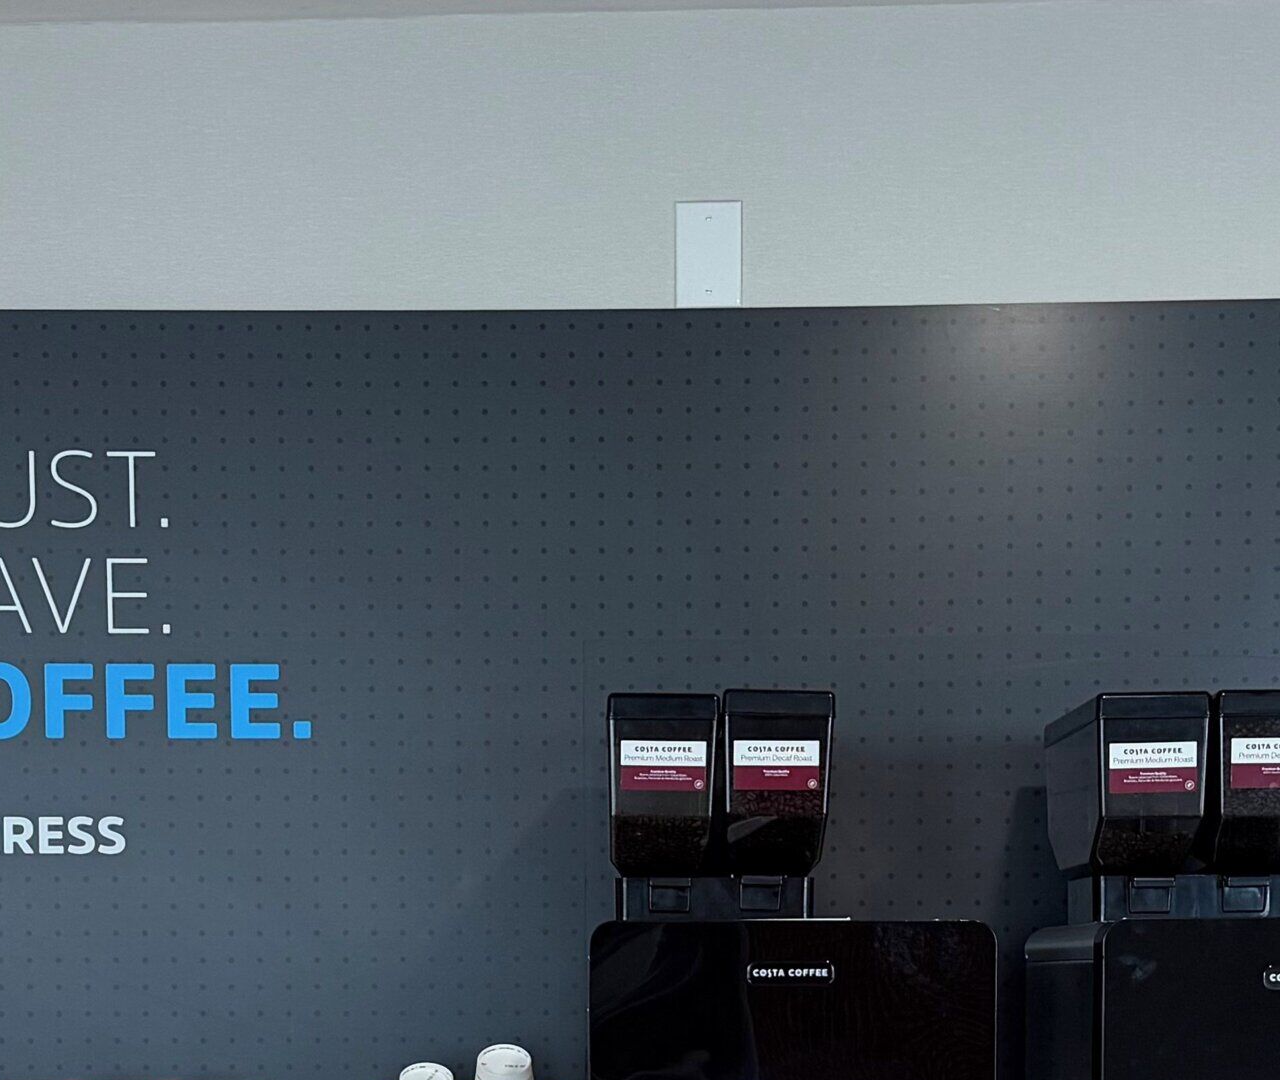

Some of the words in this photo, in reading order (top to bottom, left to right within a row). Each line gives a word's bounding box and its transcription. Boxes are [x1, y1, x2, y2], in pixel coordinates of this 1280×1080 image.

[747, 745, 772, 753] COSTA
[624, 754, 655, 762] Premium
[740, 754, 771, 762] Premium
[1238, 751, 1269, 759] Premium
[1112, 757, 1144, 765] Premium
[752, 968, 785, 978] COSTA
[787, 968, 829, 977] COFFEE
